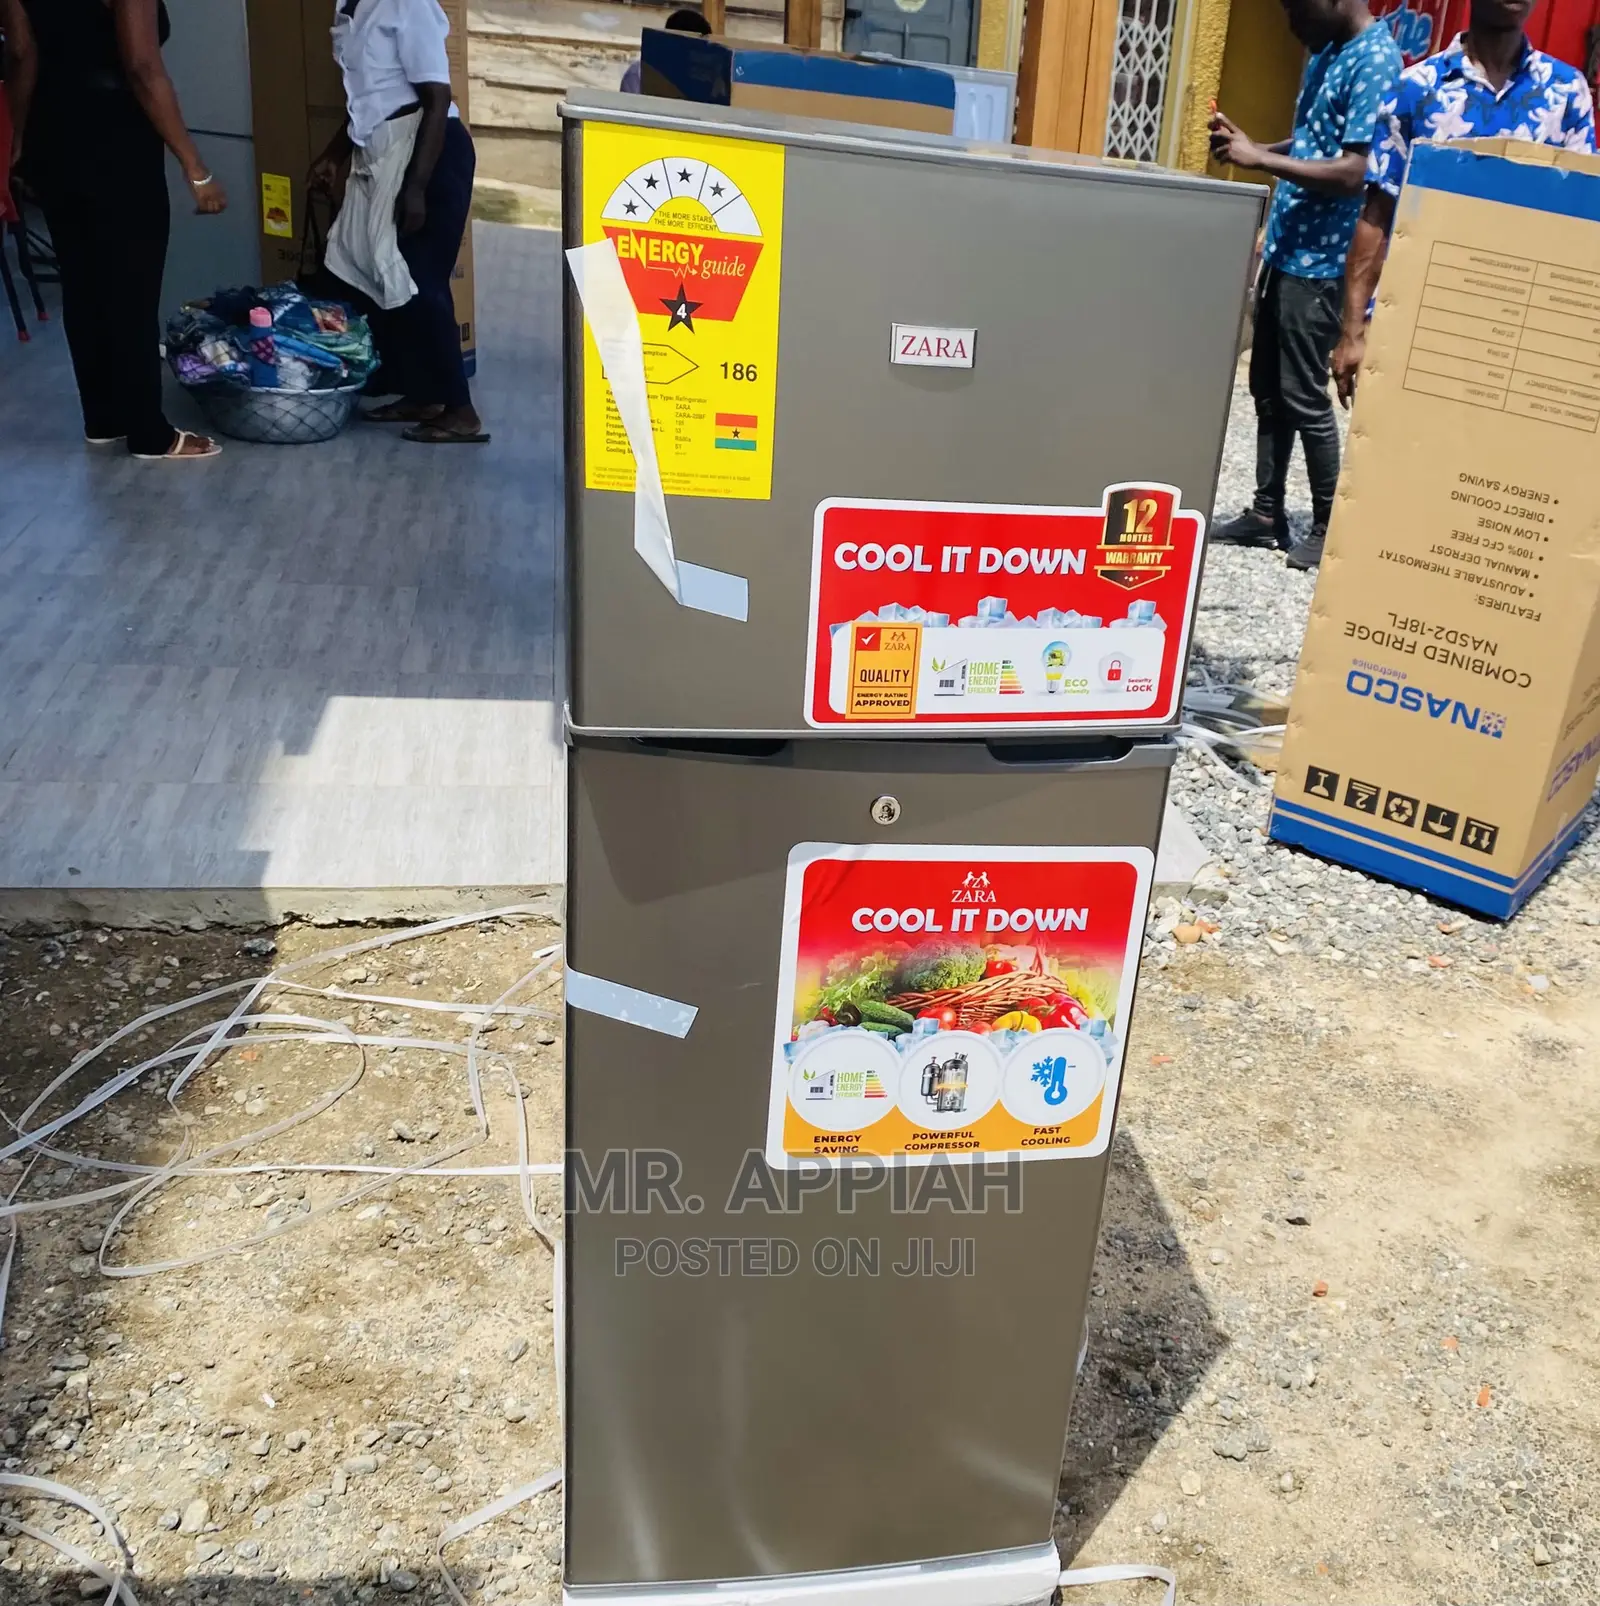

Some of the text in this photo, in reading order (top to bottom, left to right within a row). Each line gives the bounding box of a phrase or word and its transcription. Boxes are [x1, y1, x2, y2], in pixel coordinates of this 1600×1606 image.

[658, 210, 713, 223] THE MORE STARS
[654, 218, 718, 231] THE MORE EFFICIENT
[617, 229, 704, 269] ENERGY
[700, 256, 746, 280] guide
[676, 303, 688, 319] 4
[901, 334, 968, 359] ZARA
[720, 361, 758, 382] 186
[1458, 472, 1550, 504] ENERGY SAVING
[1450, 490, 1545, 523] DIRECT COOLING
[1123, 499, 1158, 533] 12
[1477, 516, 1541, 542] LOW NOISE
[1120, 534, 1153, 543] MONTHS
[1450, 529, 1535, 560] 100% CFC FREE
[833, 542, 1087, 575] COOL IT DOWN
[1105, 552, 1163, 564] WARRANTY
[1429, 544, 1531, 579] MANUAL DEFROST
[1378, 549, 1526, 597] ADJUSTABLE THERMOSTAT
[1474, 594, 1541, 622] FEATURES:
[1387, 612, 1498, 656] NASD2-18FL
[884, 642, 911, 651] ZARA
[1343, 621, 1532, 689] COMBINED FRIDGE
[860, 669, 910, 683] QUALITY
[969, 662, 1000, 676] HOME
[1352, 658, 1407, 680] electronics
[968, 676, 998, 686] ENERGY
[1064, 679, 1088, 688] ECO
[967, 686, 997, 694] EFFICIENCY
[1126, 684, 1153, 693] LOCK
[855, 699, 910, 707] APPROVED
[1346, 670, 1481, 730] NASCO
[951, 889, 996, 903] ZARA
[851, 907, 1089, 933] COOL IT DOWN
[836, 1071, 865, 1083] HOME
[836, 1083, 864, 1092] ENERGY
[912, 1131, 975, 1141] POWERFUL
[1033, 1126, 1062, 1136] FAST
[813, 1134, 862, 1144] ENERGY
[904, 1141, 981, 1151] COMPRESSOR
[1021, 1136, 1071, 1146] COOLING
[813, 1145, 859, 1155] SAVING
